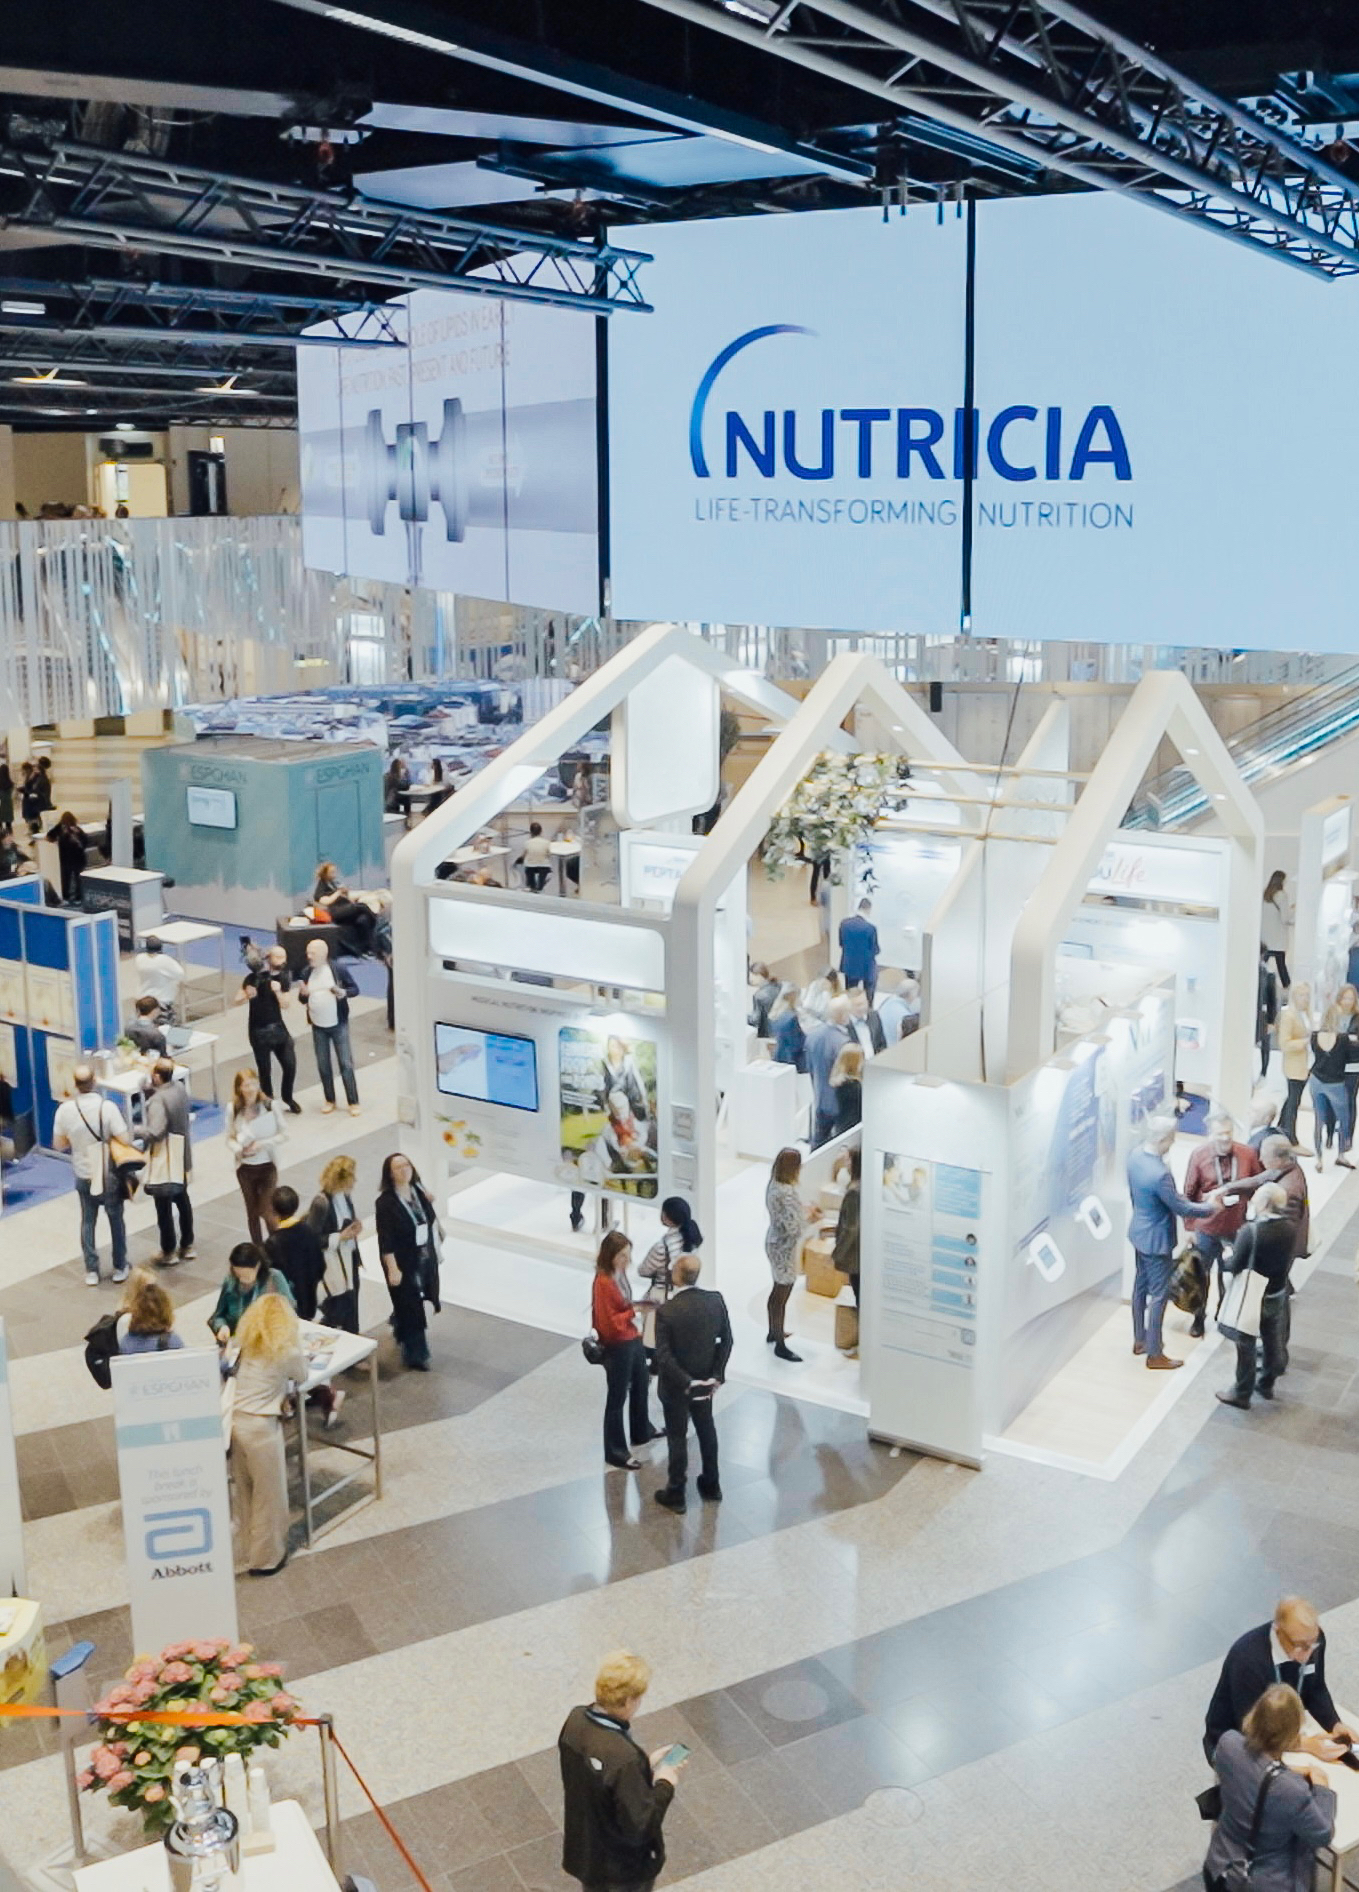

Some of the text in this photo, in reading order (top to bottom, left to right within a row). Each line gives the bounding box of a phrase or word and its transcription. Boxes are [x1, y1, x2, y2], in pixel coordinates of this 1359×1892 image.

[725, 405, 1133, 482] NUTRICIA
[694, 498, 1134, 529] LIFE-TRANSFORMING NUTRITION
[151, 1561, 214, 1580] Abbott
